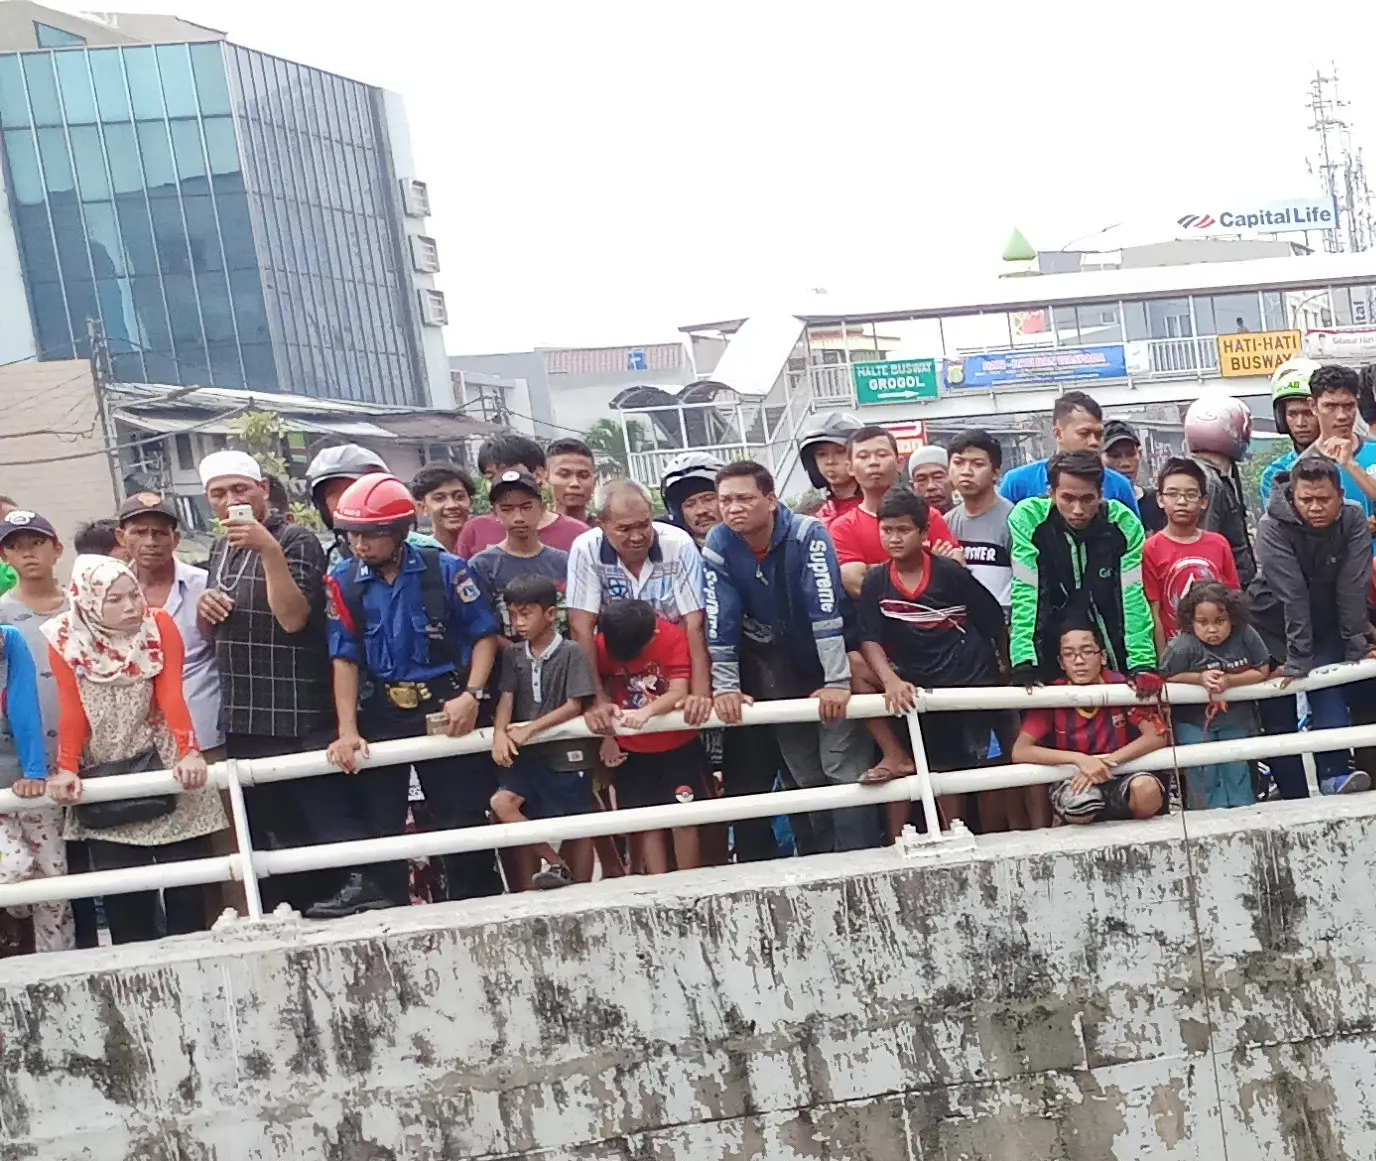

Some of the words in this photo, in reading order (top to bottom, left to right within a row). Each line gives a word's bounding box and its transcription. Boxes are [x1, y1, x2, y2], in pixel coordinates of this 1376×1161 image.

[1219, 207, 1291, 229] Capital
[1293, 206, 1332, 223] Life
[1223, 335, 1297, 354] HATI-HATI
[856, 364, 889, 377] HALTE
[890, 361, 932, 375] BUSWAY
[1230, 353, 1293, 371] BUSWAY
[868, 376, 926, 390] GROGOL
[809, 539, 835, 614] Supreme
